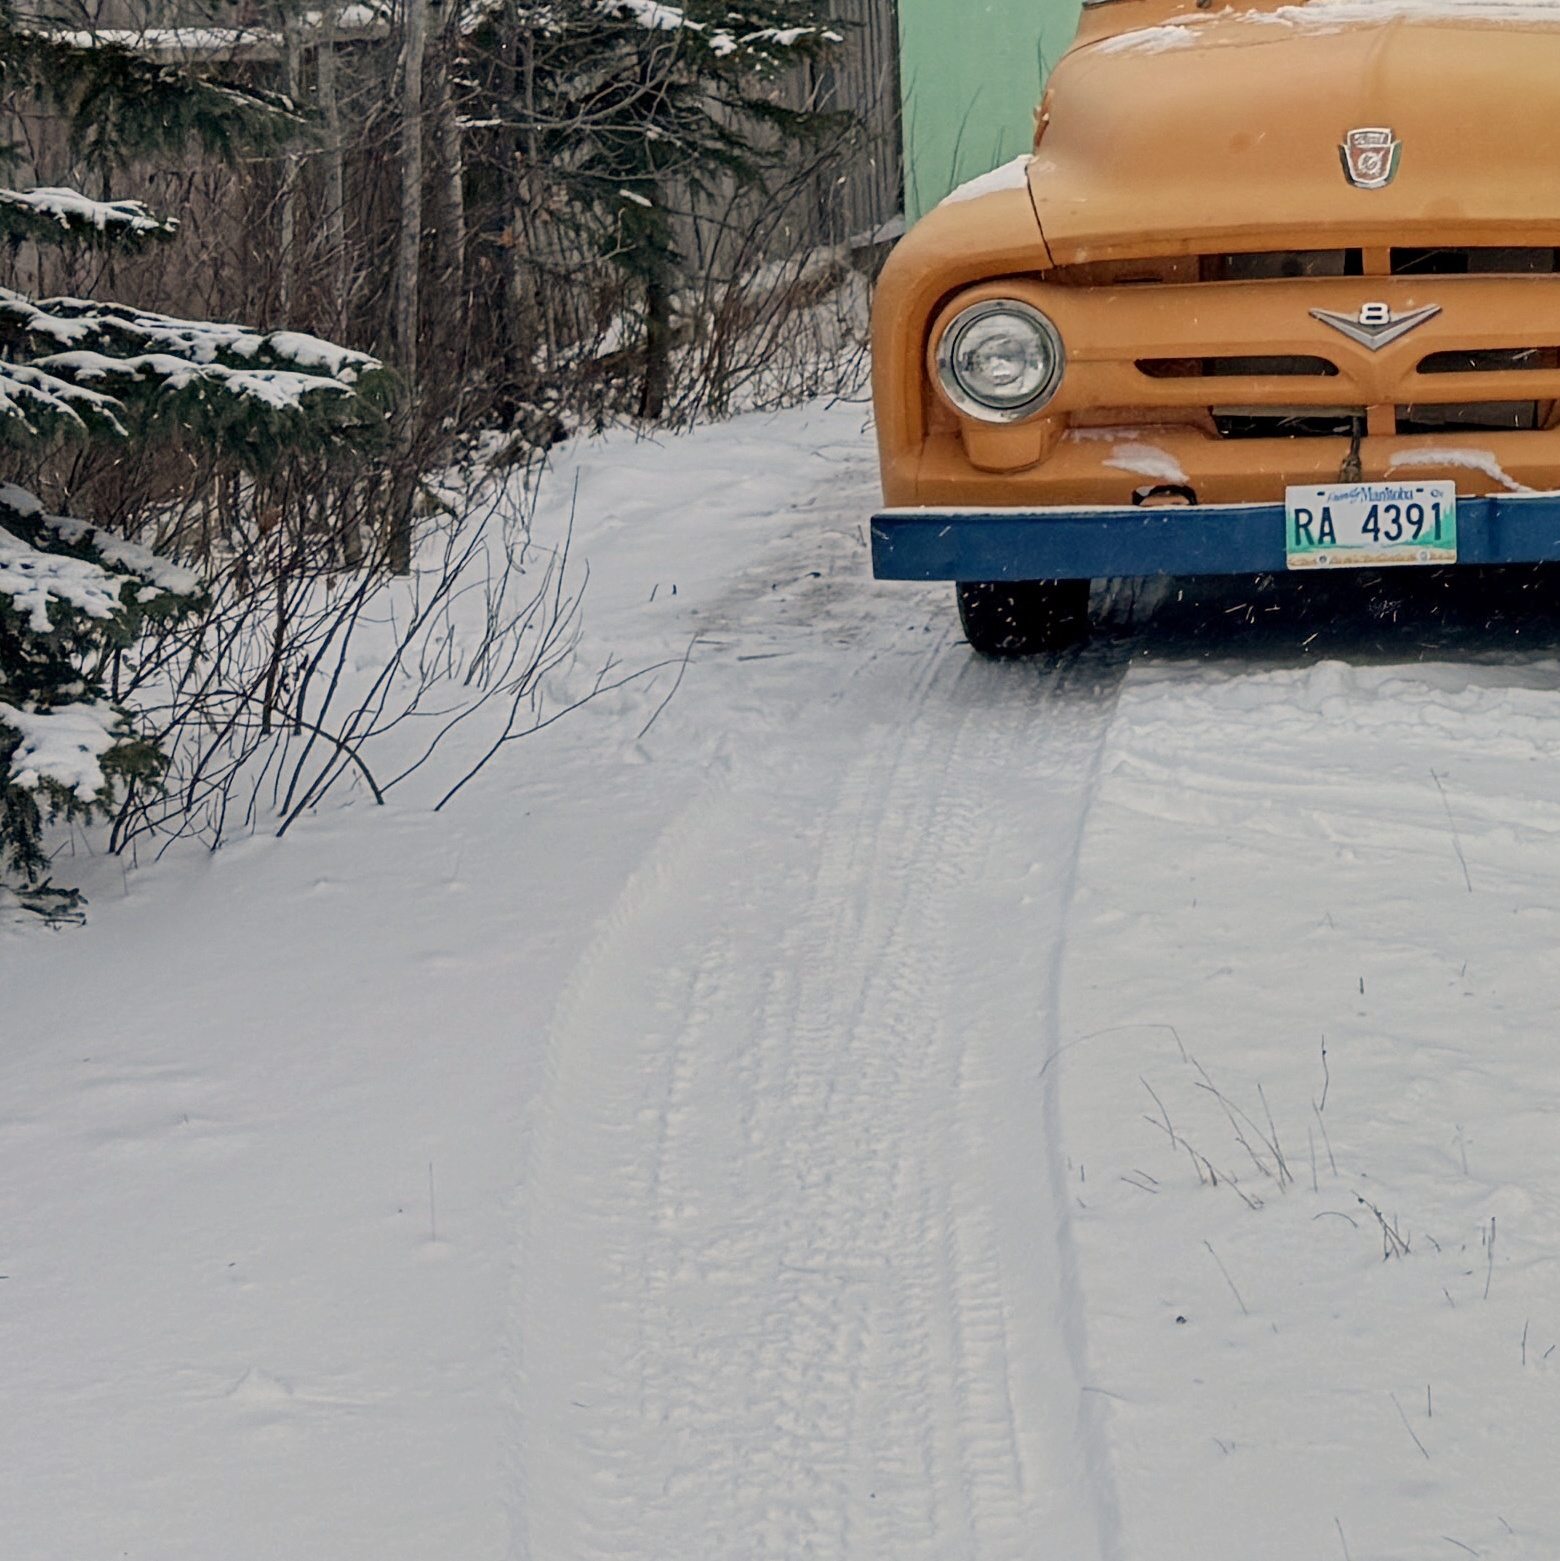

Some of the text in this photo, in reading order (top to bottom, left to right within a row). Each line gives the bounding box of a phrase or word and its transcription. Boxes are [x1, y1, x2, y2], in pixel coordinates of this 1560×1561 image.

[1361, 486, 1414, 502] Manitoba
[1294, 502, 1442, 546] RA 4391
